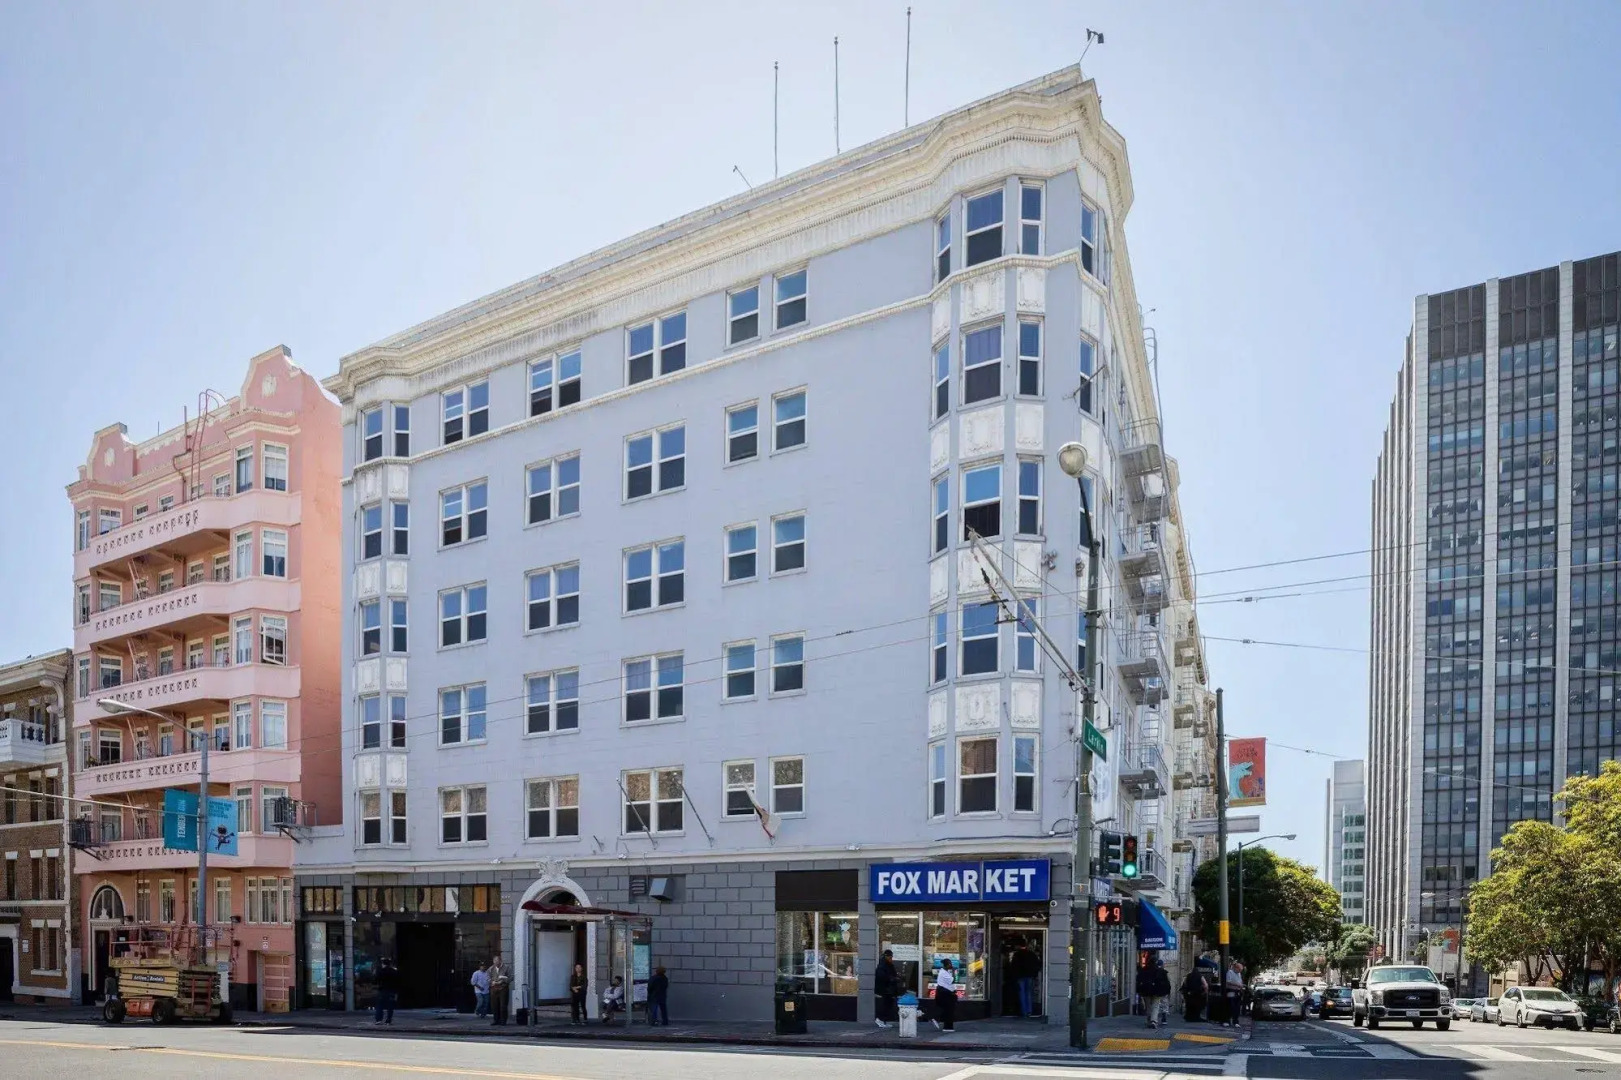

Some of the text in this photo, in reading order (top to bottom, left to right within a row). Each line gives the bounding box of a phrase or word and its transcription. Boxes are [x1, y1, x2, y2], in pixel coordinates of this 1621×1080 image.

[1088, 729, 1103, 753] Larkin
[878, 868, 1036, 895] FOX MARKET
[1113, 907, 1120, 922] 9
